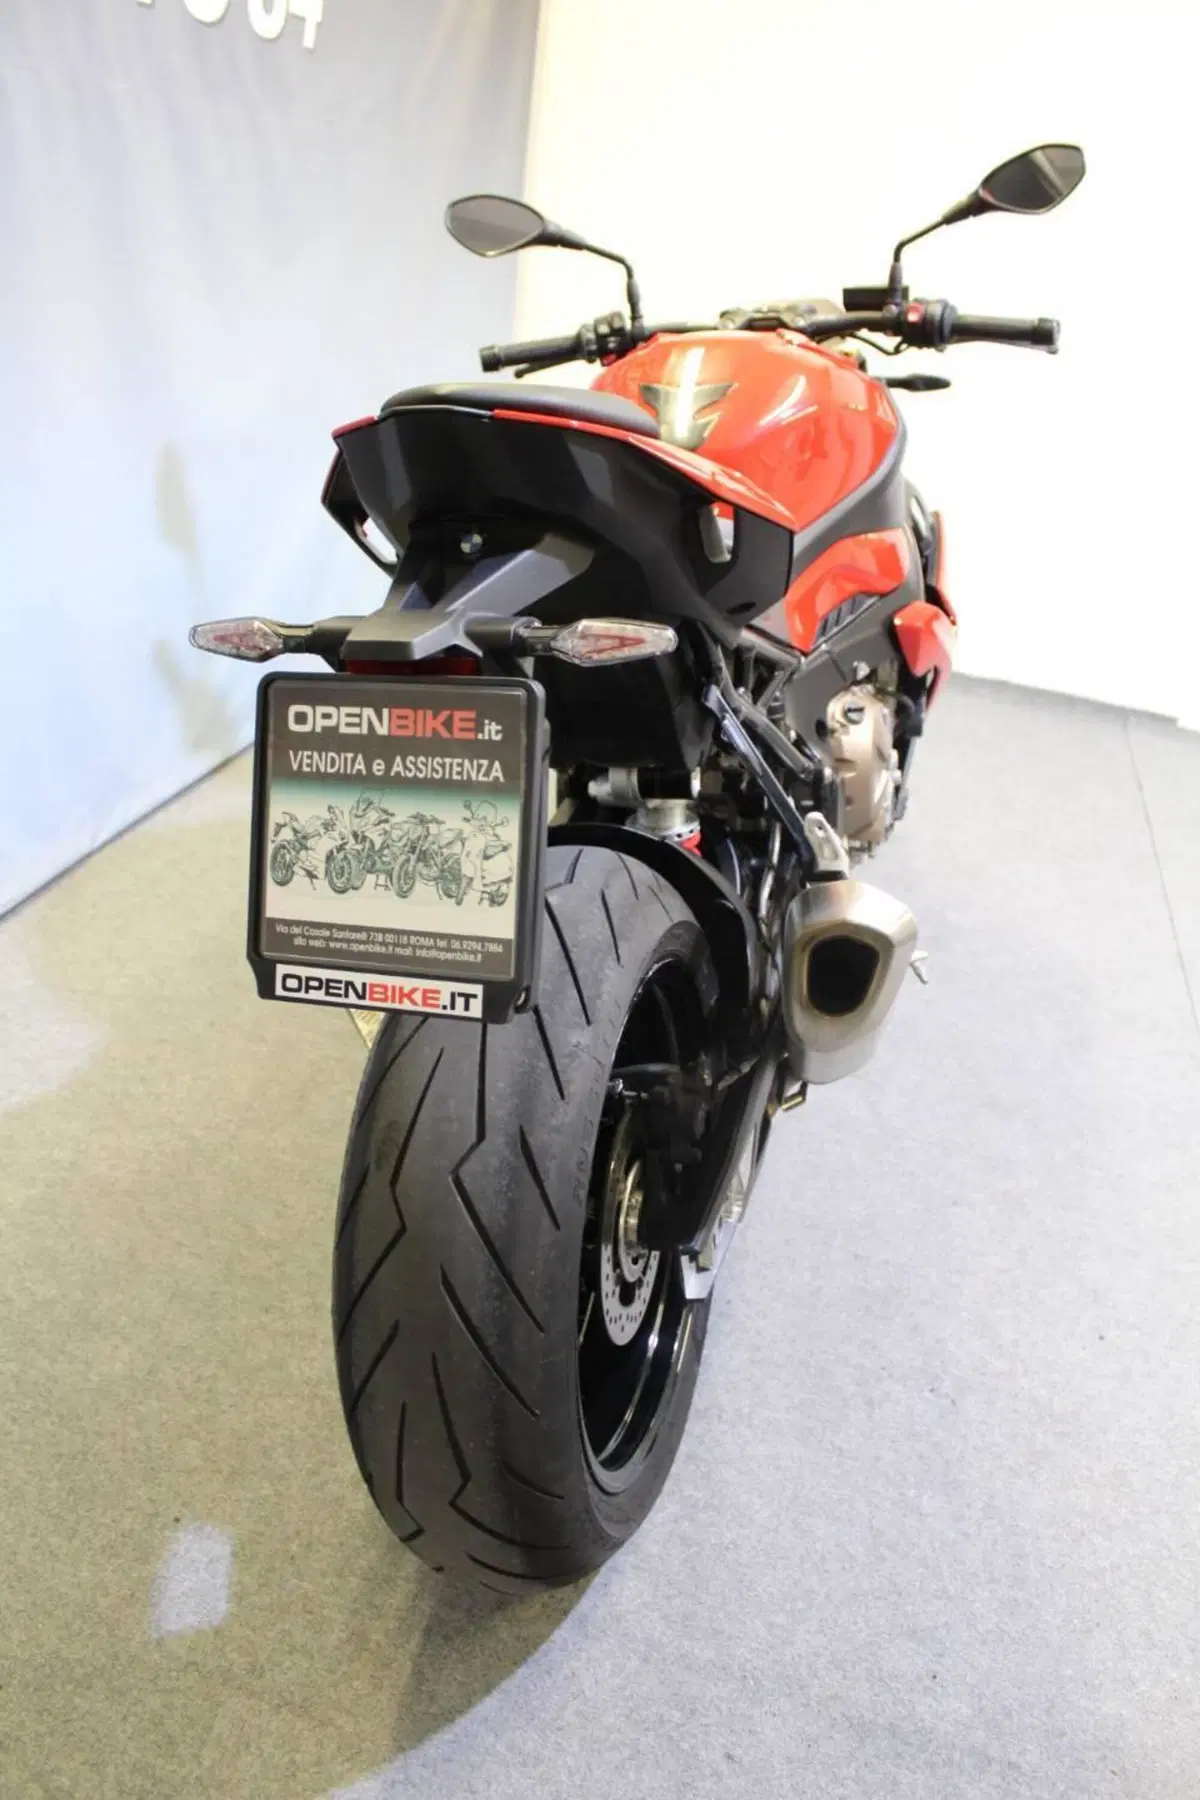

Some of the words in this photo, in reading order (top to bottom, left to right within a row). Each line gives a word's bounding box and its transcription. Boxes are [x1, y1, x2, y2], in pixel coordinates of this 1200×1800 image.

[287, 704, 503, 741] OPENBIKE.it
[289, 750, 366, 775] VENDITA
[372, 759, 385, 774] e
[390, 755, 505, 782] ASSISTENZA
[275, 923, 289, 934] Via
[290, 925, 302, 934] del
[303, 926, 331, 937] Casale
[409, 935, 435, 947] ROMA
[281, 973, 478, 1012] OPENBIKE.IT
